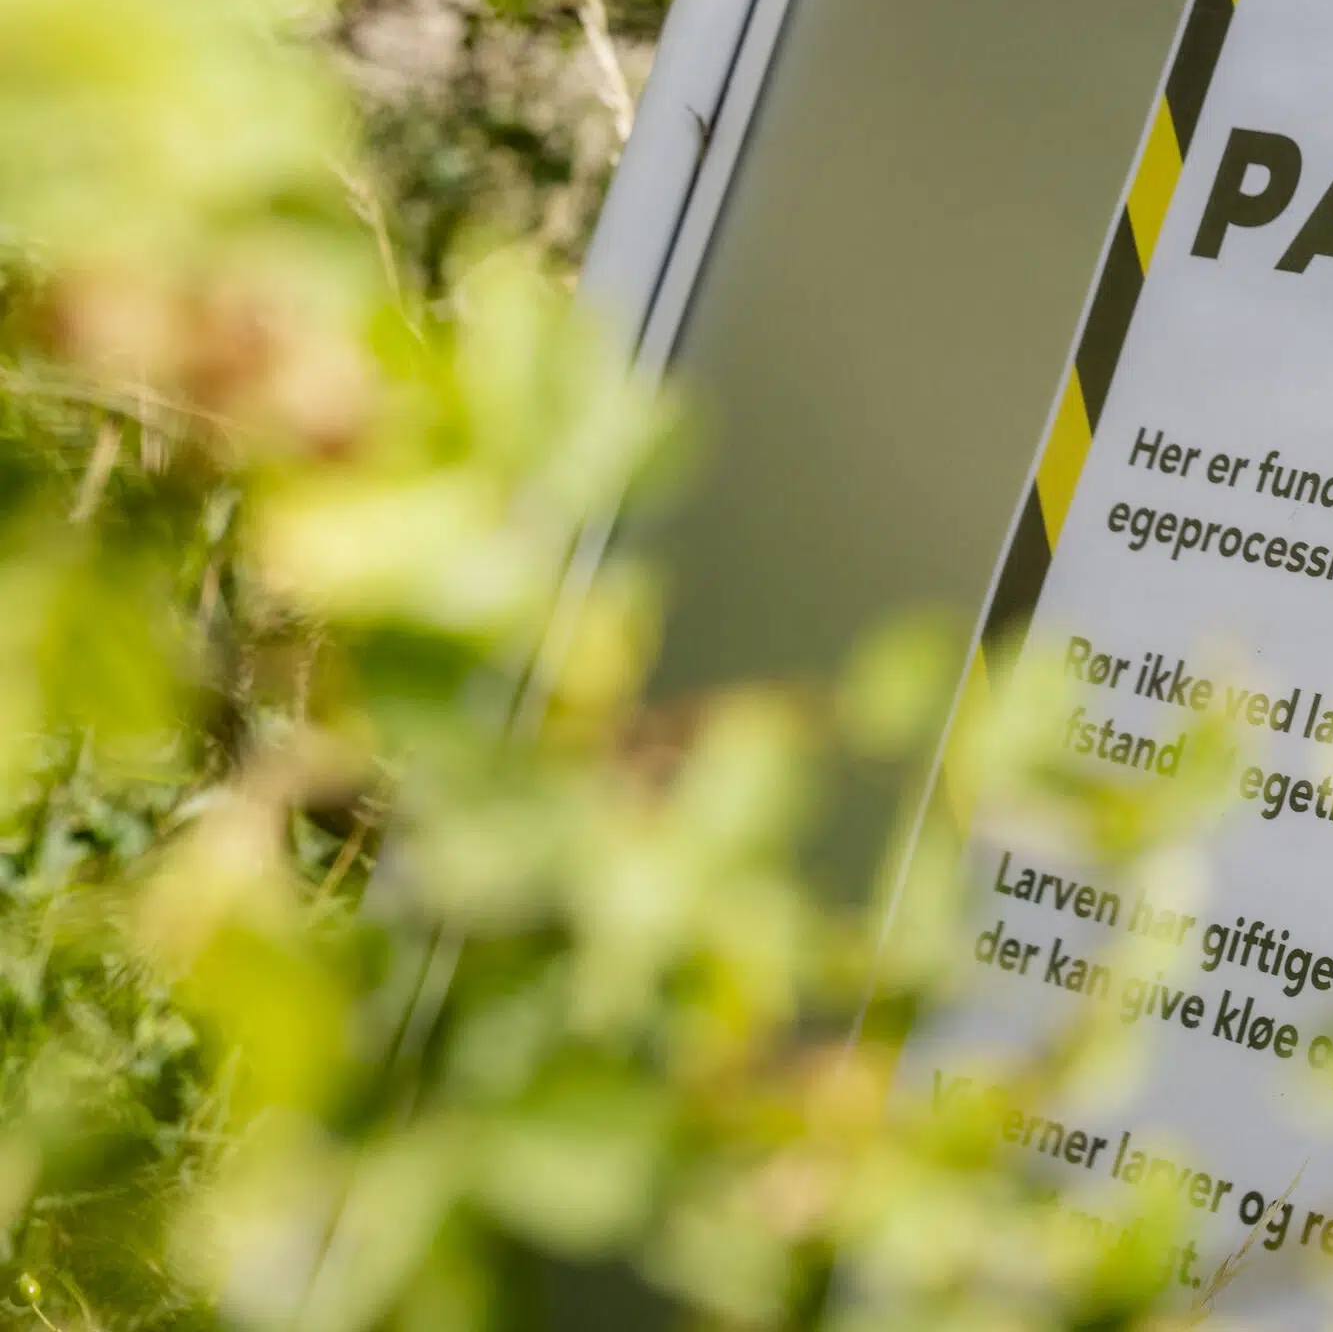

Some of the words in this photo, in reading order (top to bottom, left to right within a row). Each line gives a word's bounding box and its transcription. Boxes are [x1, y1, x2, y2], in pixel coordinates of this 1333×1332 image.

[1127, 426, 1201, 477] Her
[1206, 451, 1250, 488] er
[1064, 635, 1131, 689] Rør
[1134, 651, 1214, 711] ikke
[1224, 685, 1302, 733] ved
[993, 850, 1121, 927] Larven
[1127, 888, 1197, 947] har
[974, 920, 1041, 976] der
[1043, 937, 1112, 997] kan
[1119, 970, 1205, 1030] give
[1211, 988, 1299, 1059] kløe
[1240, 1190, 1295, 1251] og
